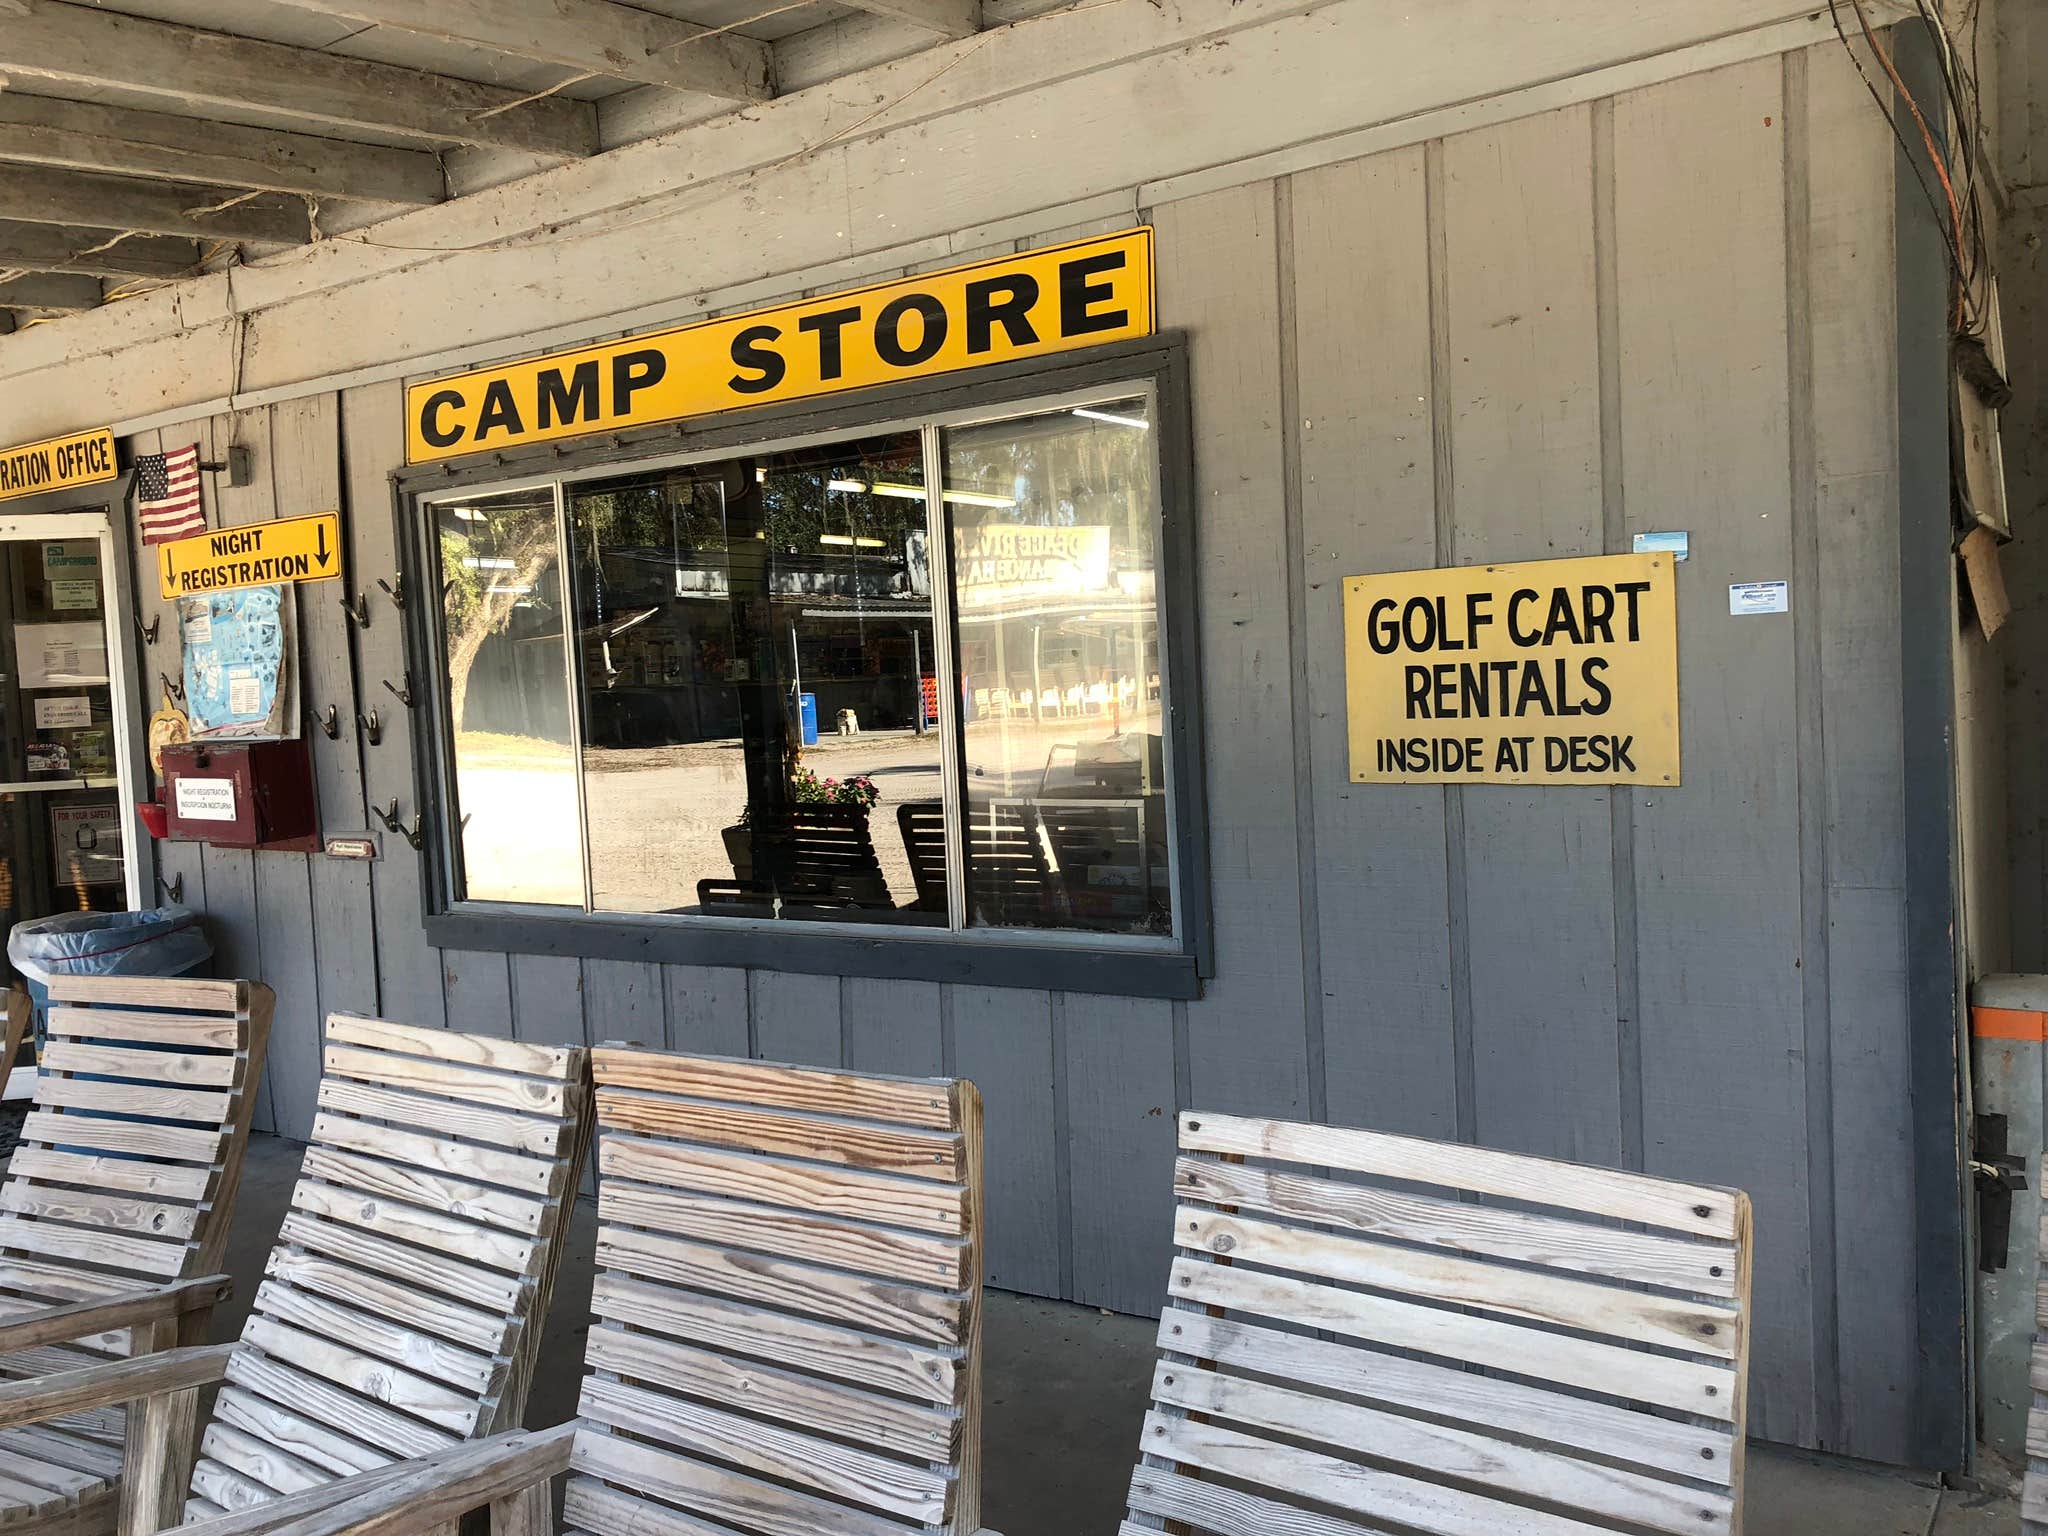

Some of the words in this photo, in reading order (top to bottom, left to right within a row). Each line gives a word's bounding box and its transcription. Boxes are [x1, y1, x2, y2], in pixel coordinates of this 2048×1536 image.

[419, 348, 666, 448] CAMP
[728, 250, 1129, 394] STORE
[0, 450, 52, 491] RATION
[56, 437, 111, 480] OFFICE
[210, 529, 263, 557] NIGHT
[181, 553, 309, 591] REGISTRATION
[1367, 592, 1493, 654] GOLF
[1507, 581, 1651, 648] CART
[1405, 656, 1612, 720] RENTALS
[1376, 737, 1483, 773] INSIDE
[1494, 736, 1535, 773] AT
[1543, 734, 1636, 773] DESK
[182, 788, 196, 796] NIGHT
[197, 788, 230, 796] REGISTRATION
[57, 811, 70, 821] FOR
[72, 811, 88, 820] YOUR
[89, 809, 111, 819] SAFETY
